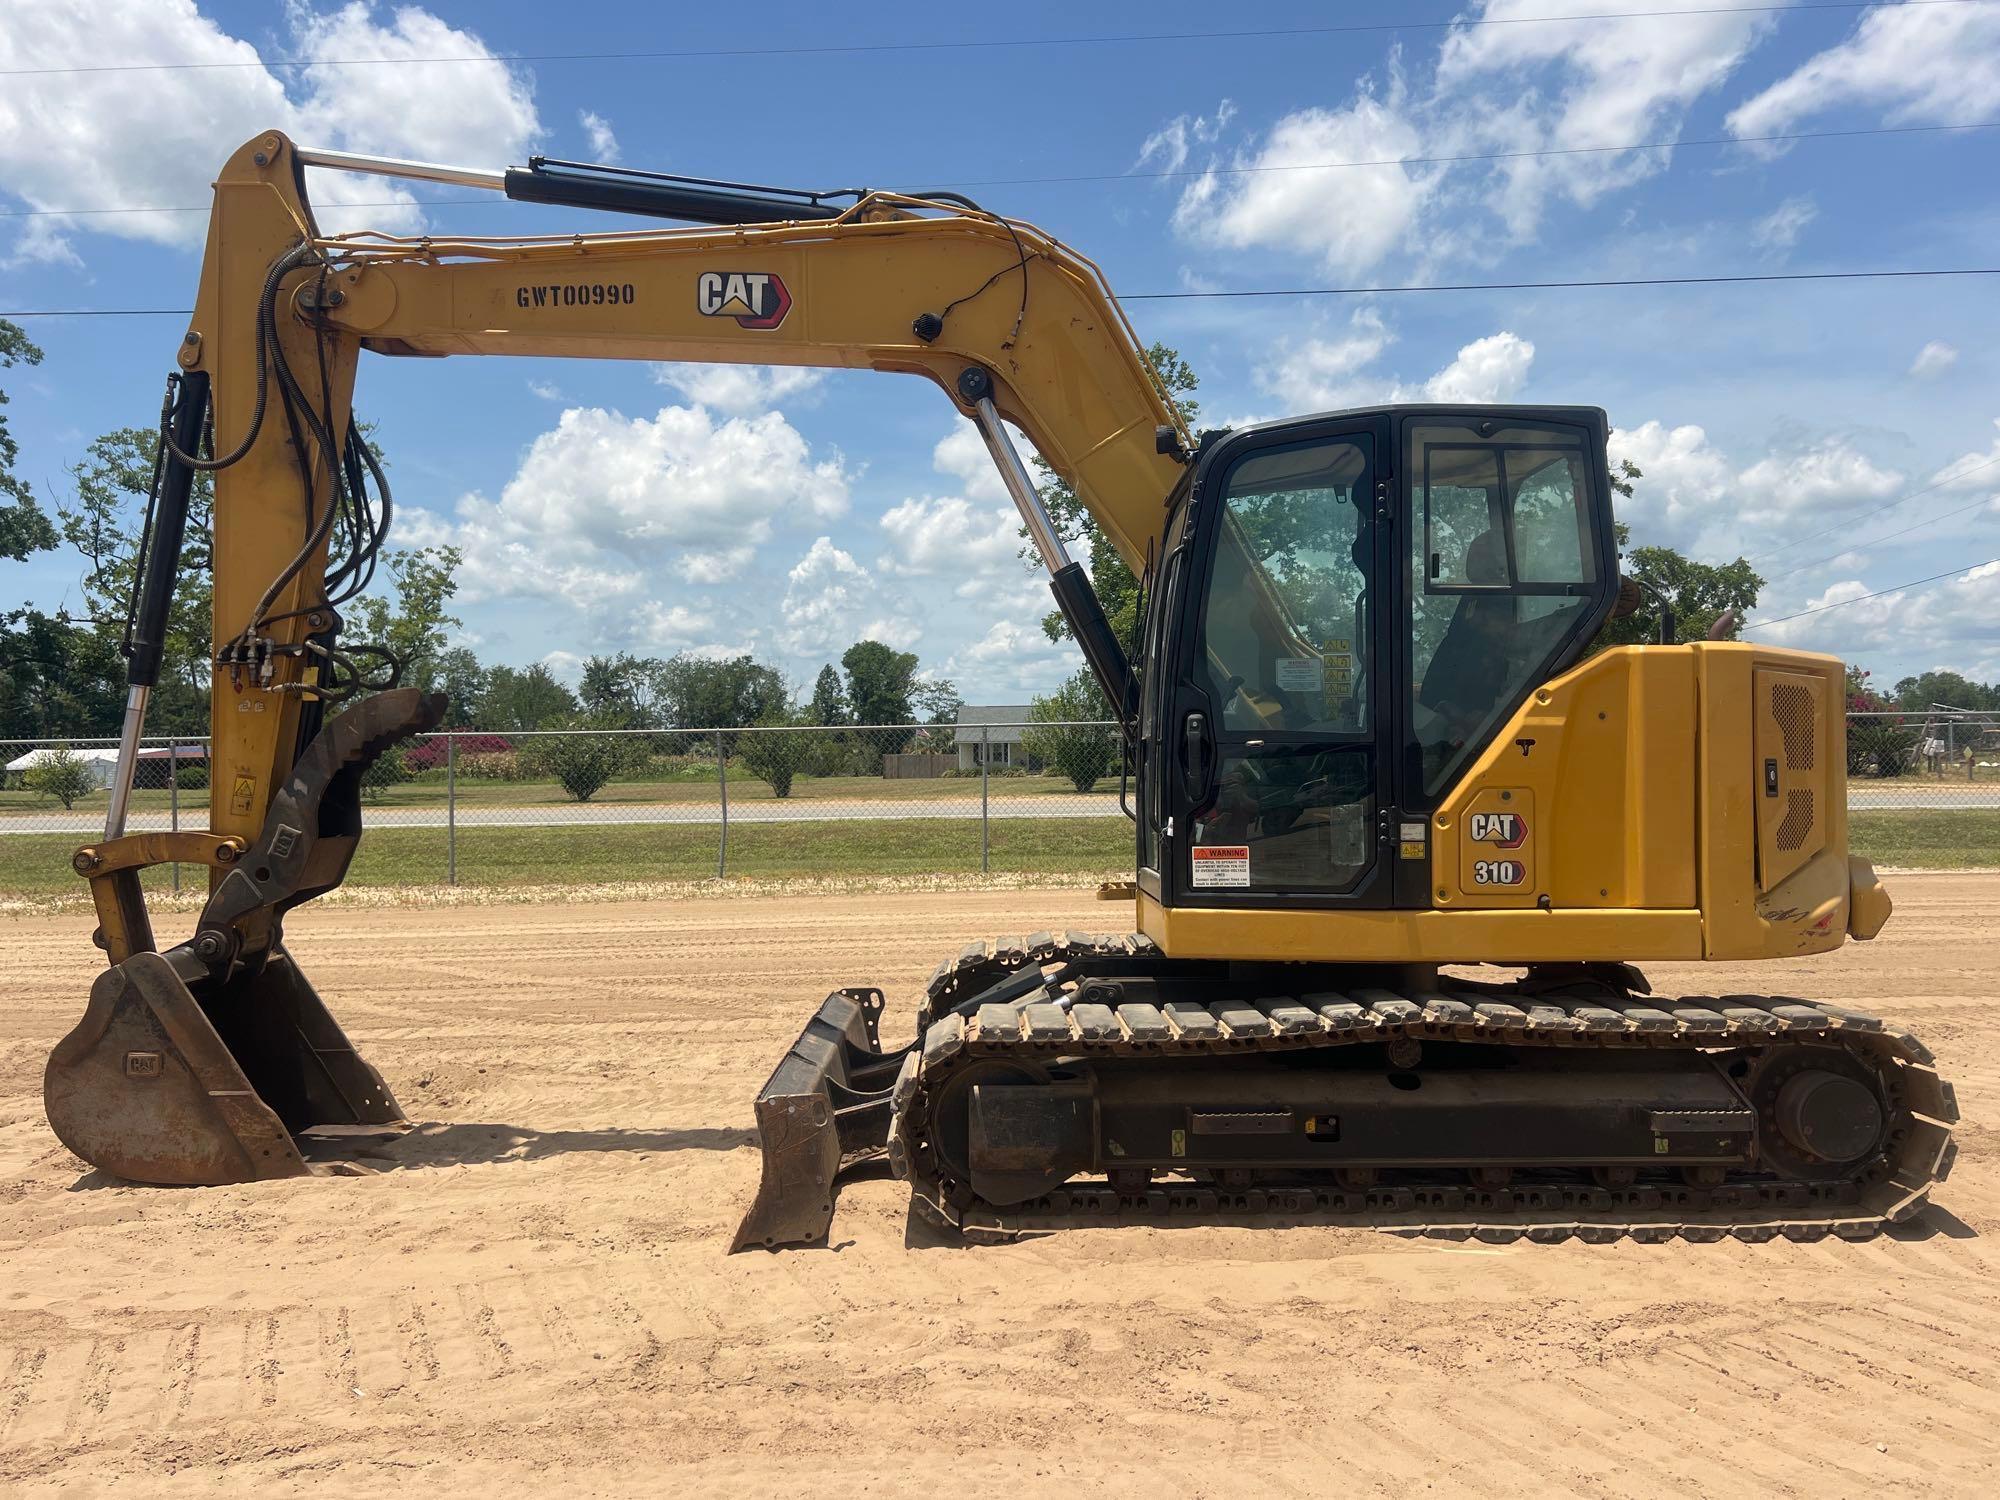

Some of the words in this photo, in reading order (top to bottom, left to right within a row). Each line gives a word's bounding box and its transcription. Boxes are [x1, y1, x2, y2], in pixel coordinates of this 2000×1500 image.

[516, 283, 635, 308] GWT00990
[699, 273, 769, 316] CAT
[1471, 814, 1514, 841] CAT
[1210, 849, 1245, 857] WARNING
[1474, 861, 1513, 884] 310
